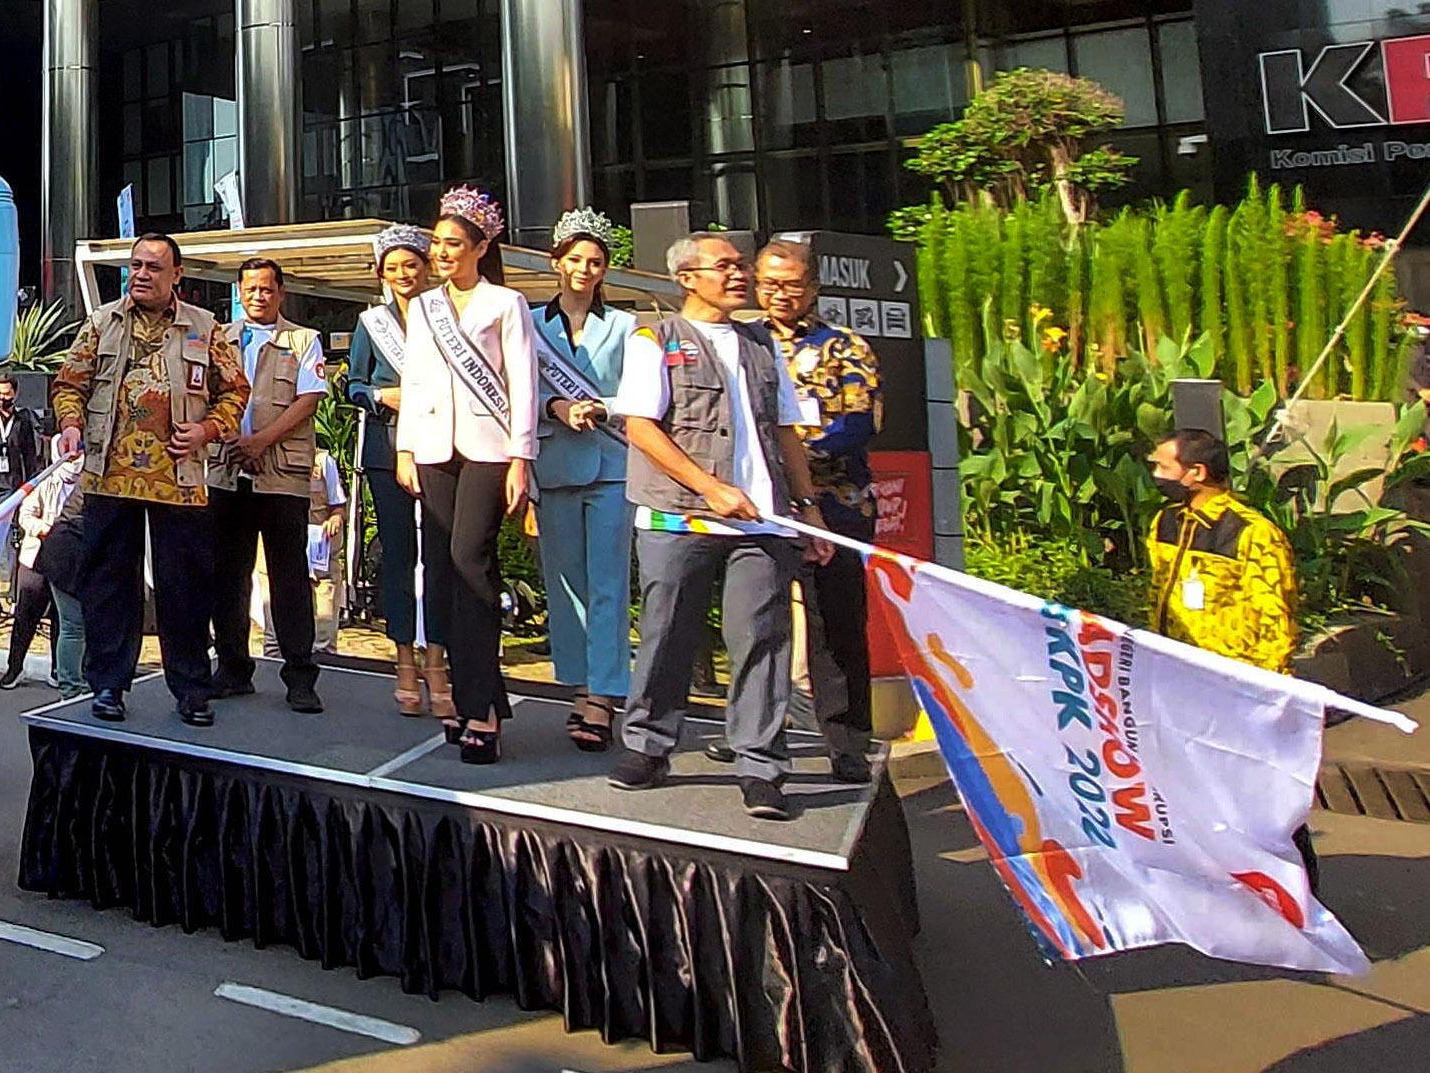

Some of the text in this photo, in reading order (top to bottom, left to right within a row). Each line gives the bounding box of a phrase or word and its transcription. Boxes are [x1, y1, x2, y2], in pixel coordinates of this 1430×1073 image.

[1271, 141, 1430, 169] Komisi Pe
[436, 316, 468, 358] PUTERI
[1061, 741, 1117, 849] 2022
